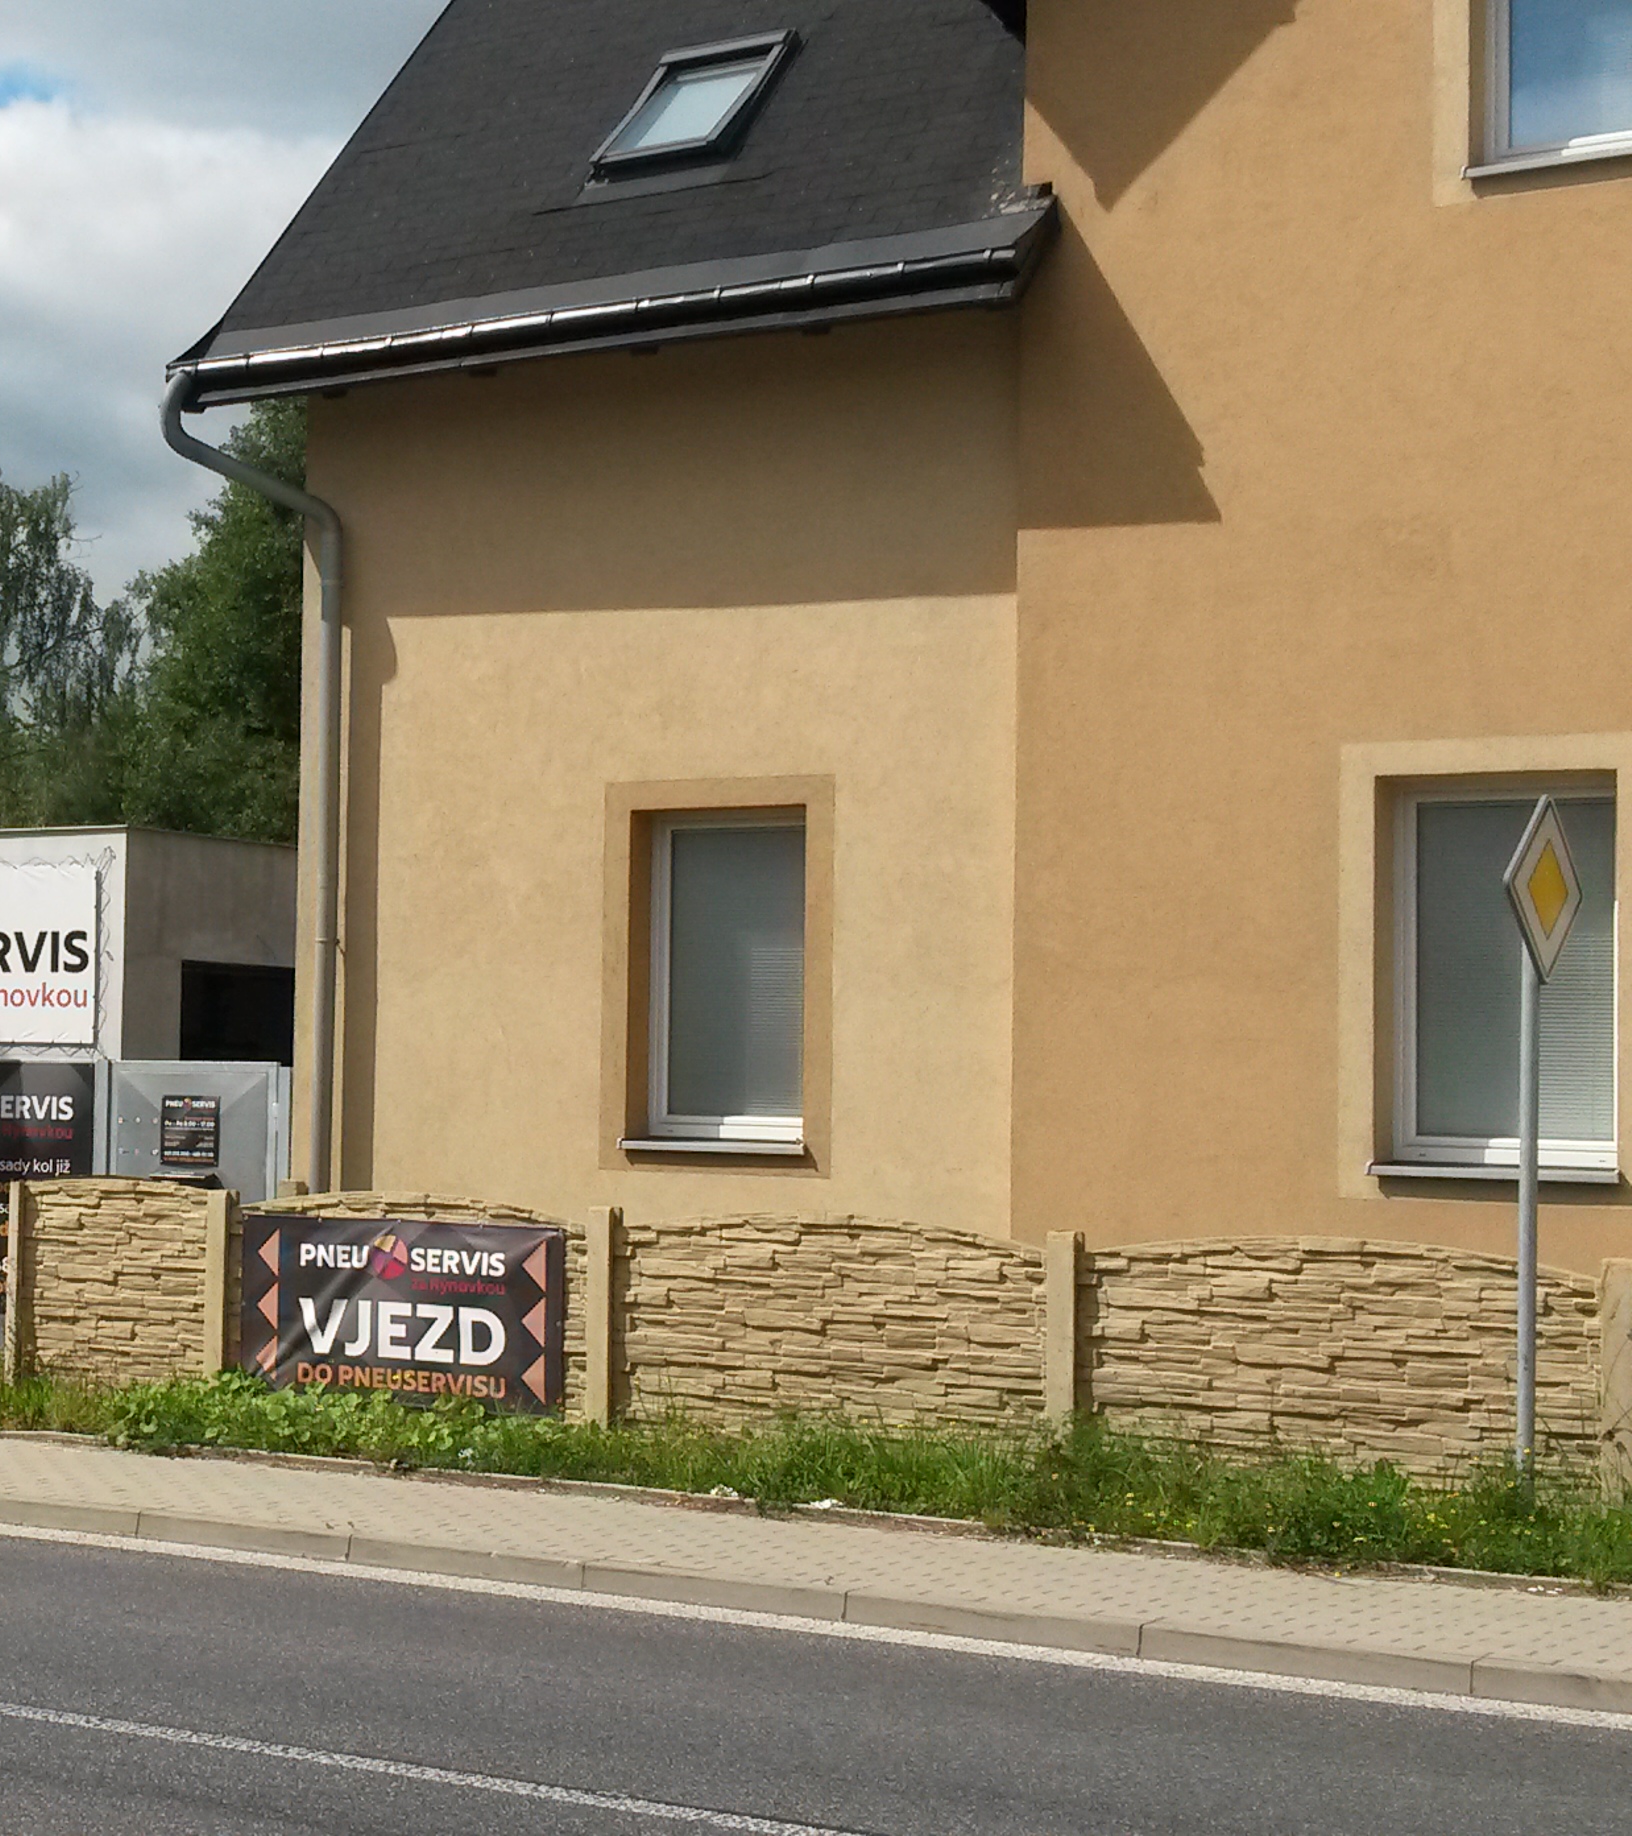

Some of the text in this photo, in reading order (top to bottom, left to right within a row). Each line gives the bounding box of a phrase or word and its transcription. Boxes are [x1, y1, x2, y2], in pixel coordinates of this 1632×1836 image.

[32, 1157, 54, 1174] kol
[54, 1158, 71, 1177] již
[299, 1242, 506, 1277] PNEU SERVIS
[411, 1278, 428, 1291] za
[298, 1296, 506, 1366] VJEZD
[296, 1361, 506, 1399] DO PNEUSERVISU
